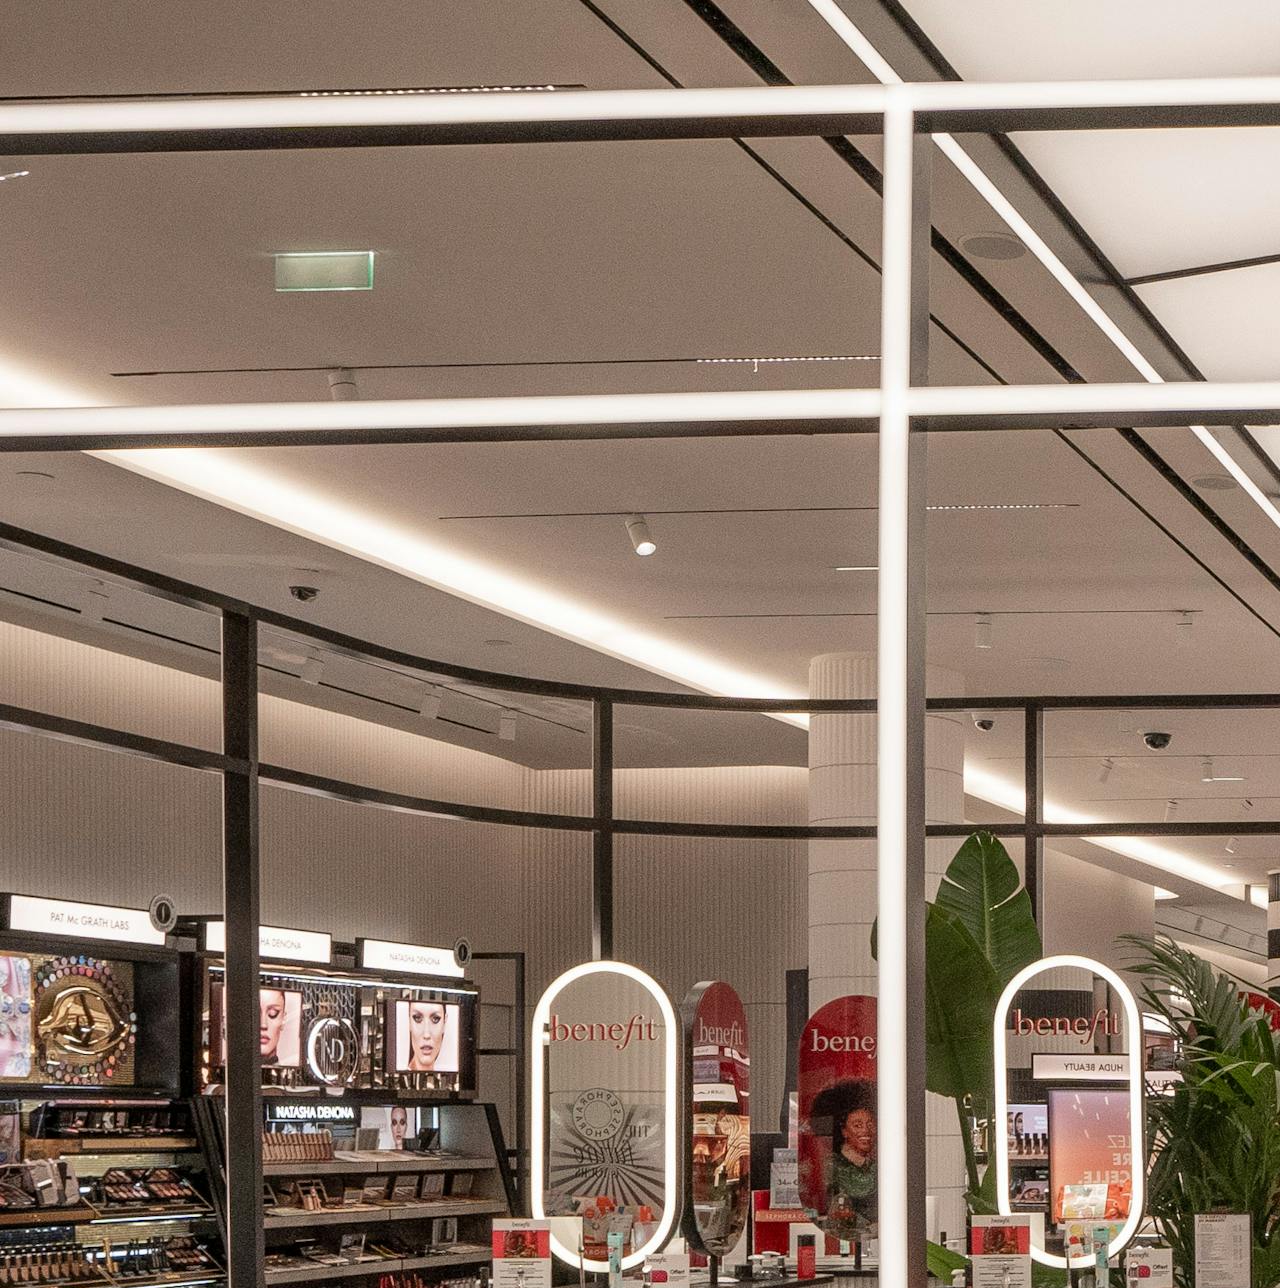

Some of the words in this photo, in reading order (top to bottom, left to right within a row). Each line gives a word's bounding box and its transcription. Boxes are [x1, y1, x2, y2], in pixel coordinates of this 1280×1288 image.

[50, 912, 64, 923] PAT
[81, 915, 109, 928] GRATH
[110, 920, 130, 931] LABS
[552, 1014, 659, 1050] benefit
[699, 1017, 744, 1048] benefit
[1013, 1009, 1122, 1045] benefit
[276, 1105, 316, 1119] NATASHA
[317, 1106, 355, 1119] DENONA
